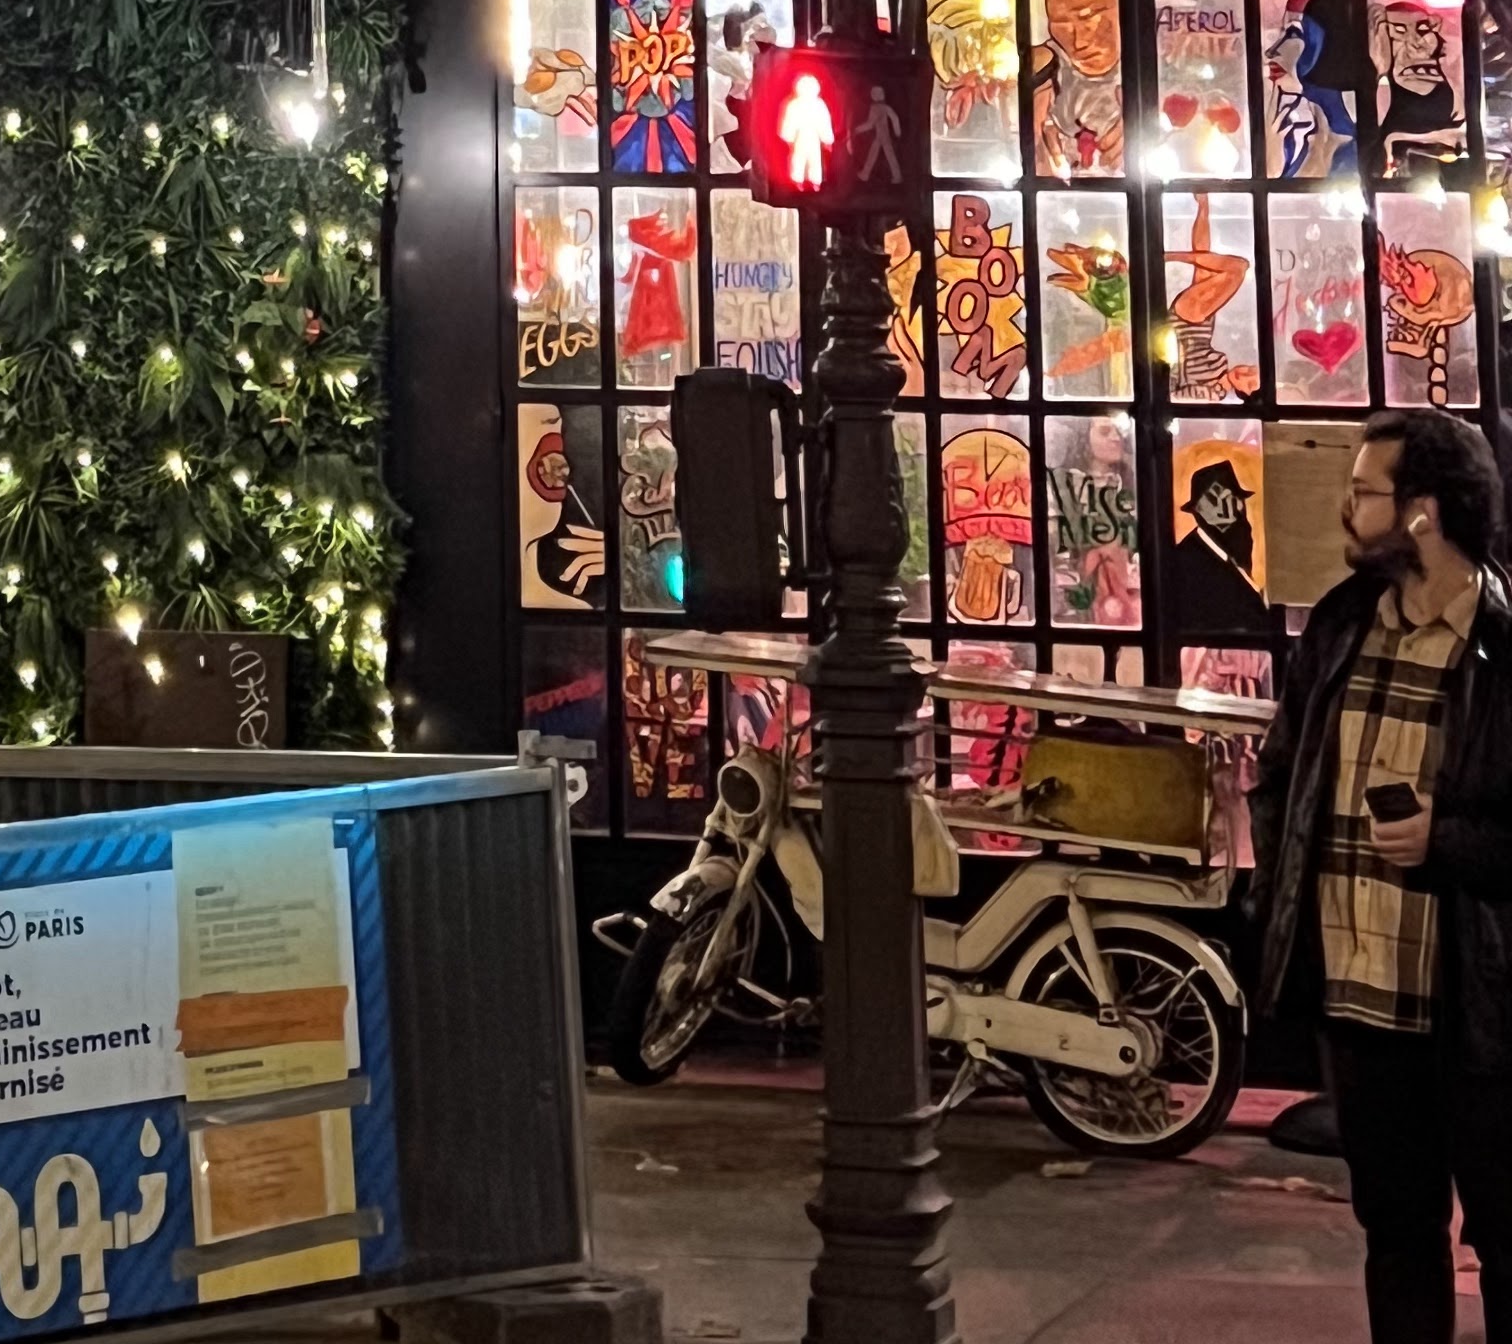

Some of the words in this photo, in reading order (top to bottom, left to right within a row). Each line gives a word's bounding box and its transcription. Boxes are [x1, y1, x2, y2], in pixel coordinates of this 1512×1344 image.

[1156, 5, 1242, 34] APEROL
[618, 30, 689, 84] POP
[946, 193, 1027, 399] BOOM
[25, 915, 85, 942] PARIS
